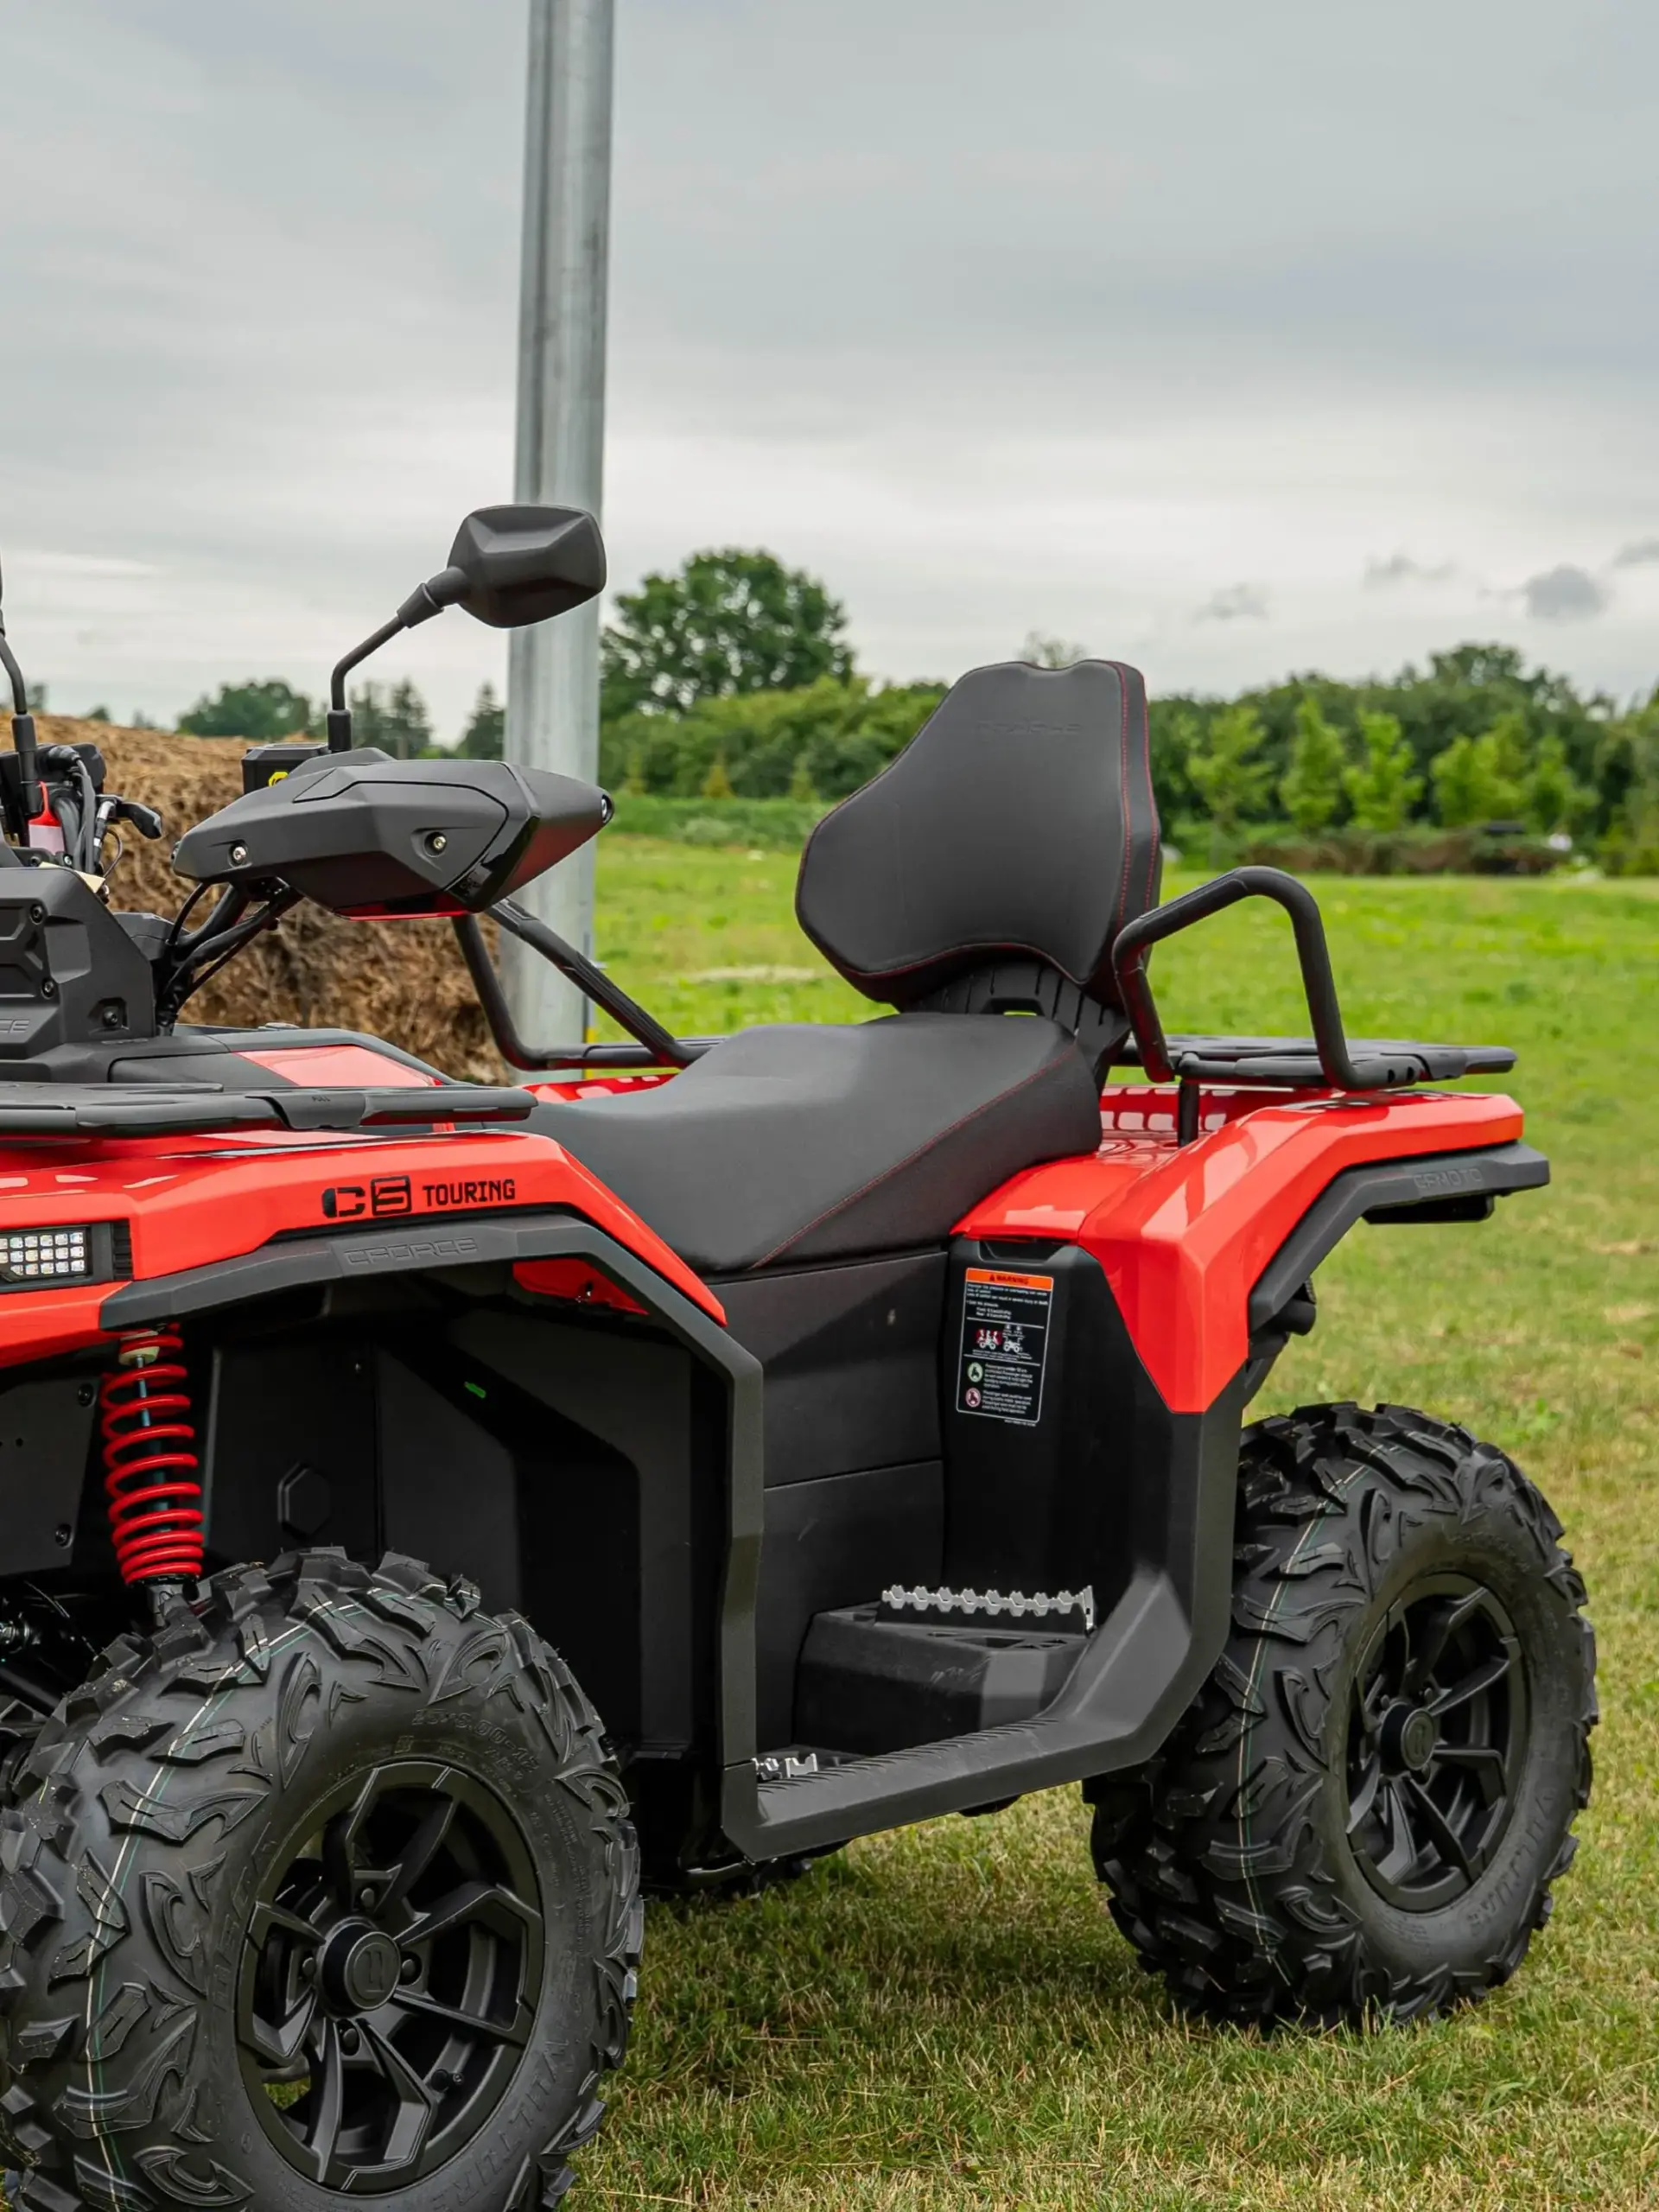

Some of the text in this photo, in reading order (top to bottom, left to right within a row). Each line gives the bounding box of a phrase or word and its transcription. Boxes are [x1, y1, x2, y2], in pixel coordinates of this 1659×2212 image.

[1413, 1168, 1484, 1189] CFMOTO
[422, 1179, 516, 1207] TOURING
[345, 1236, 479, 1266] CFORCE
